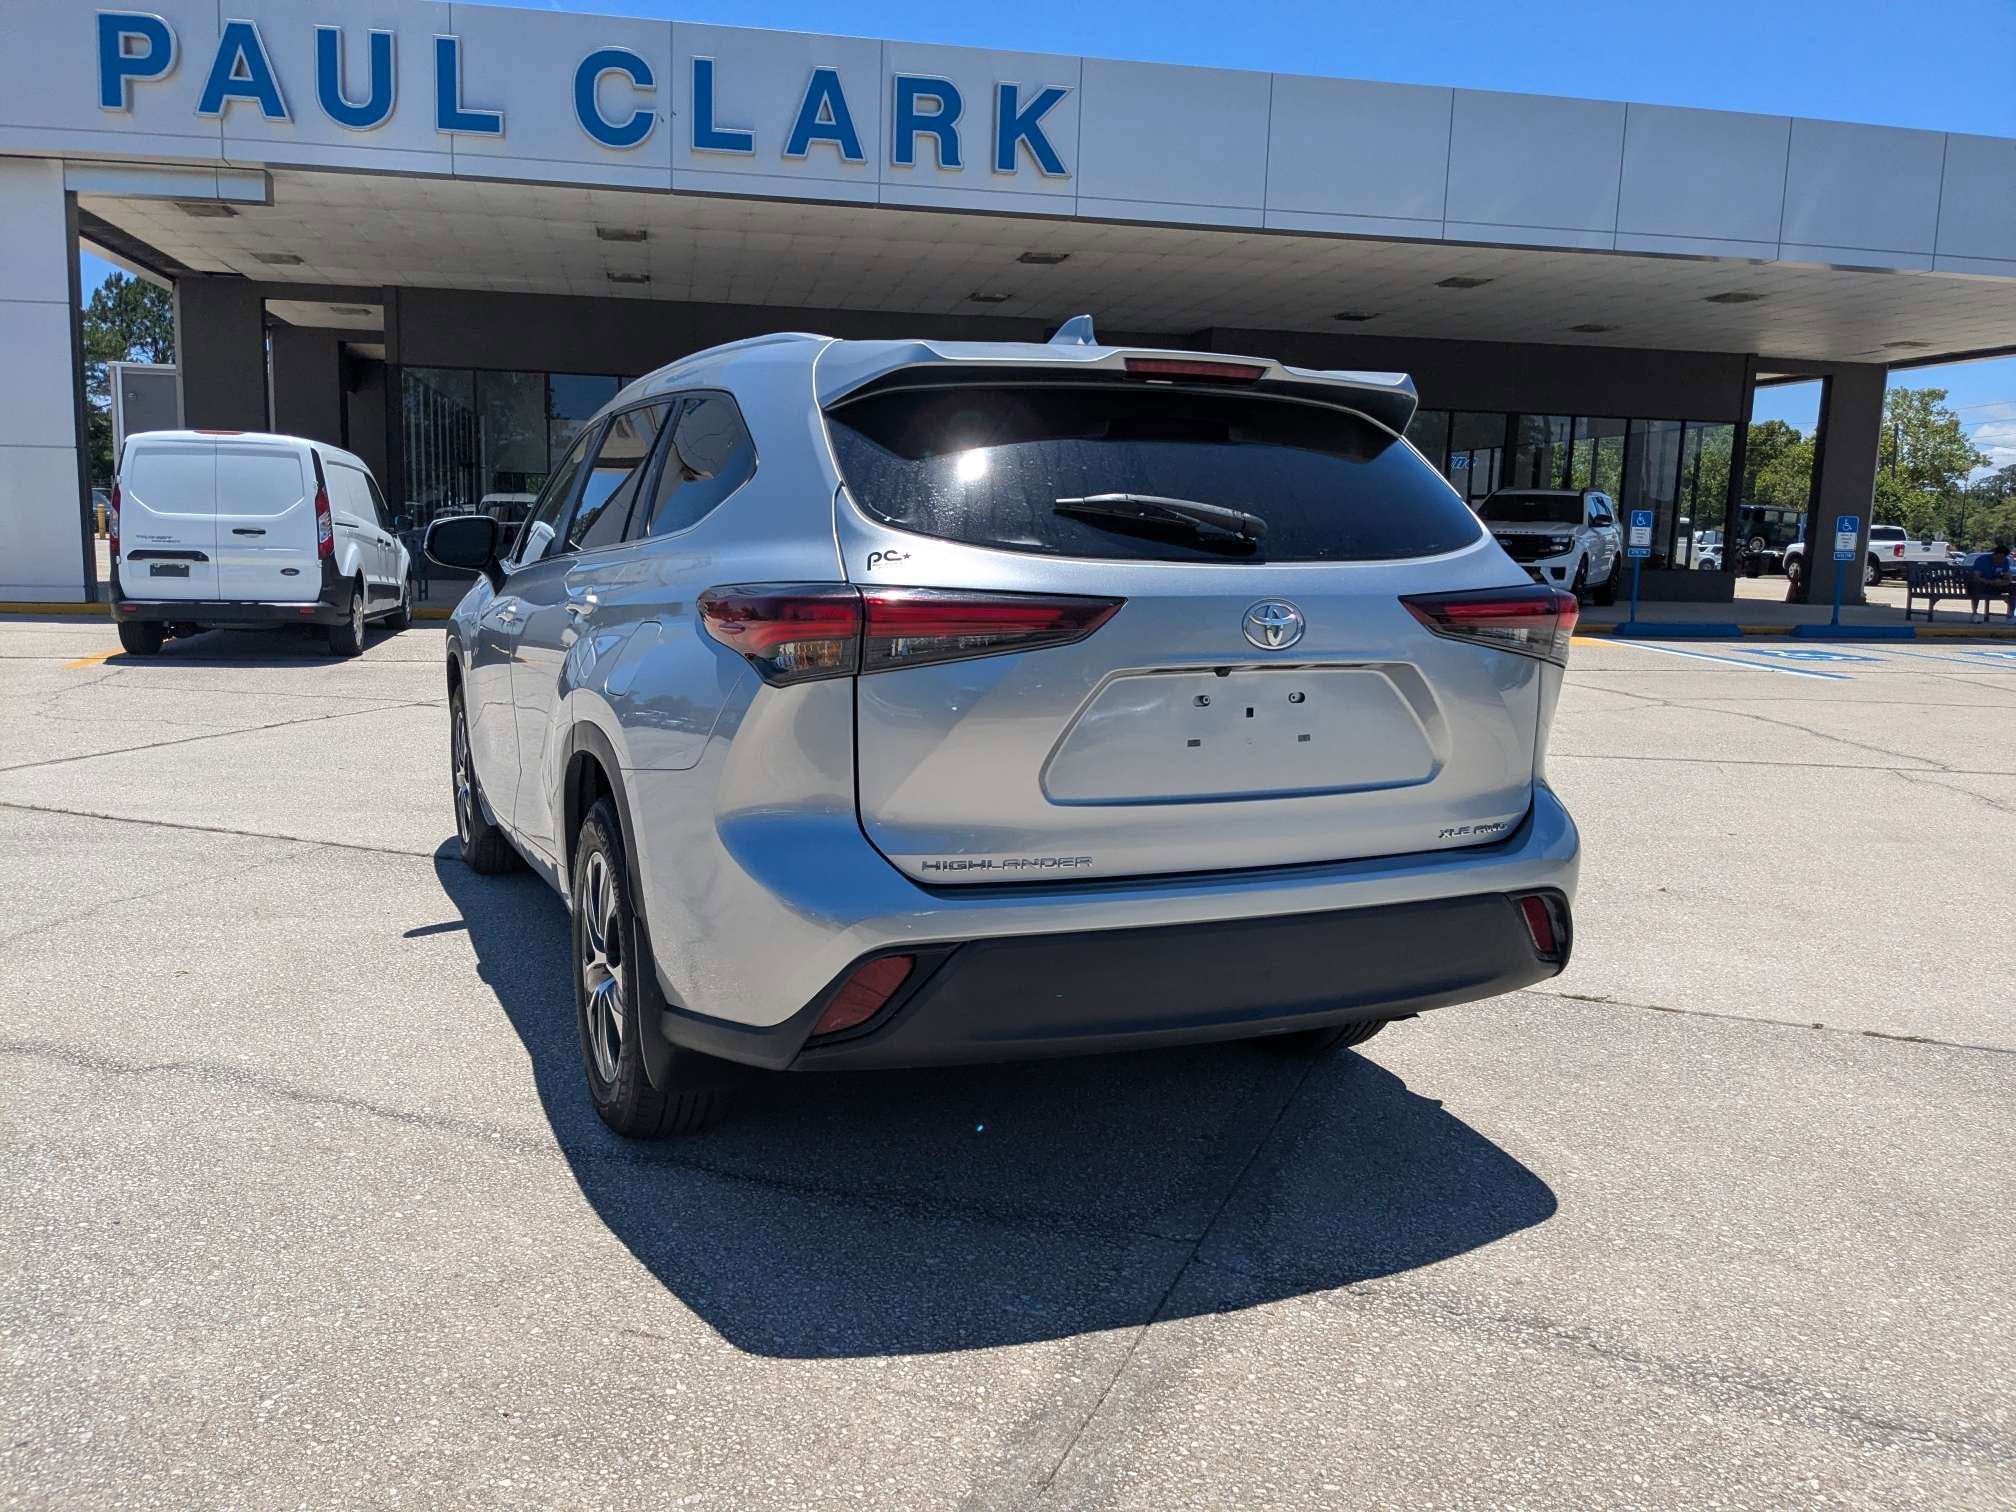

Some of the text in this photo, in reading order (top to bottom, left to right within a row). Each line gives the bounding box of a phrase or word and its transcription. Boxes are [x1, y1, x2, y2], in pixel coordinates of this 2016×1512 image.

[97, 9, 1075, 178] PAUL CLARK
[1439, 826, 1471, 838] XLE
[922, 856, 1093, 872] HIGHLANDER
